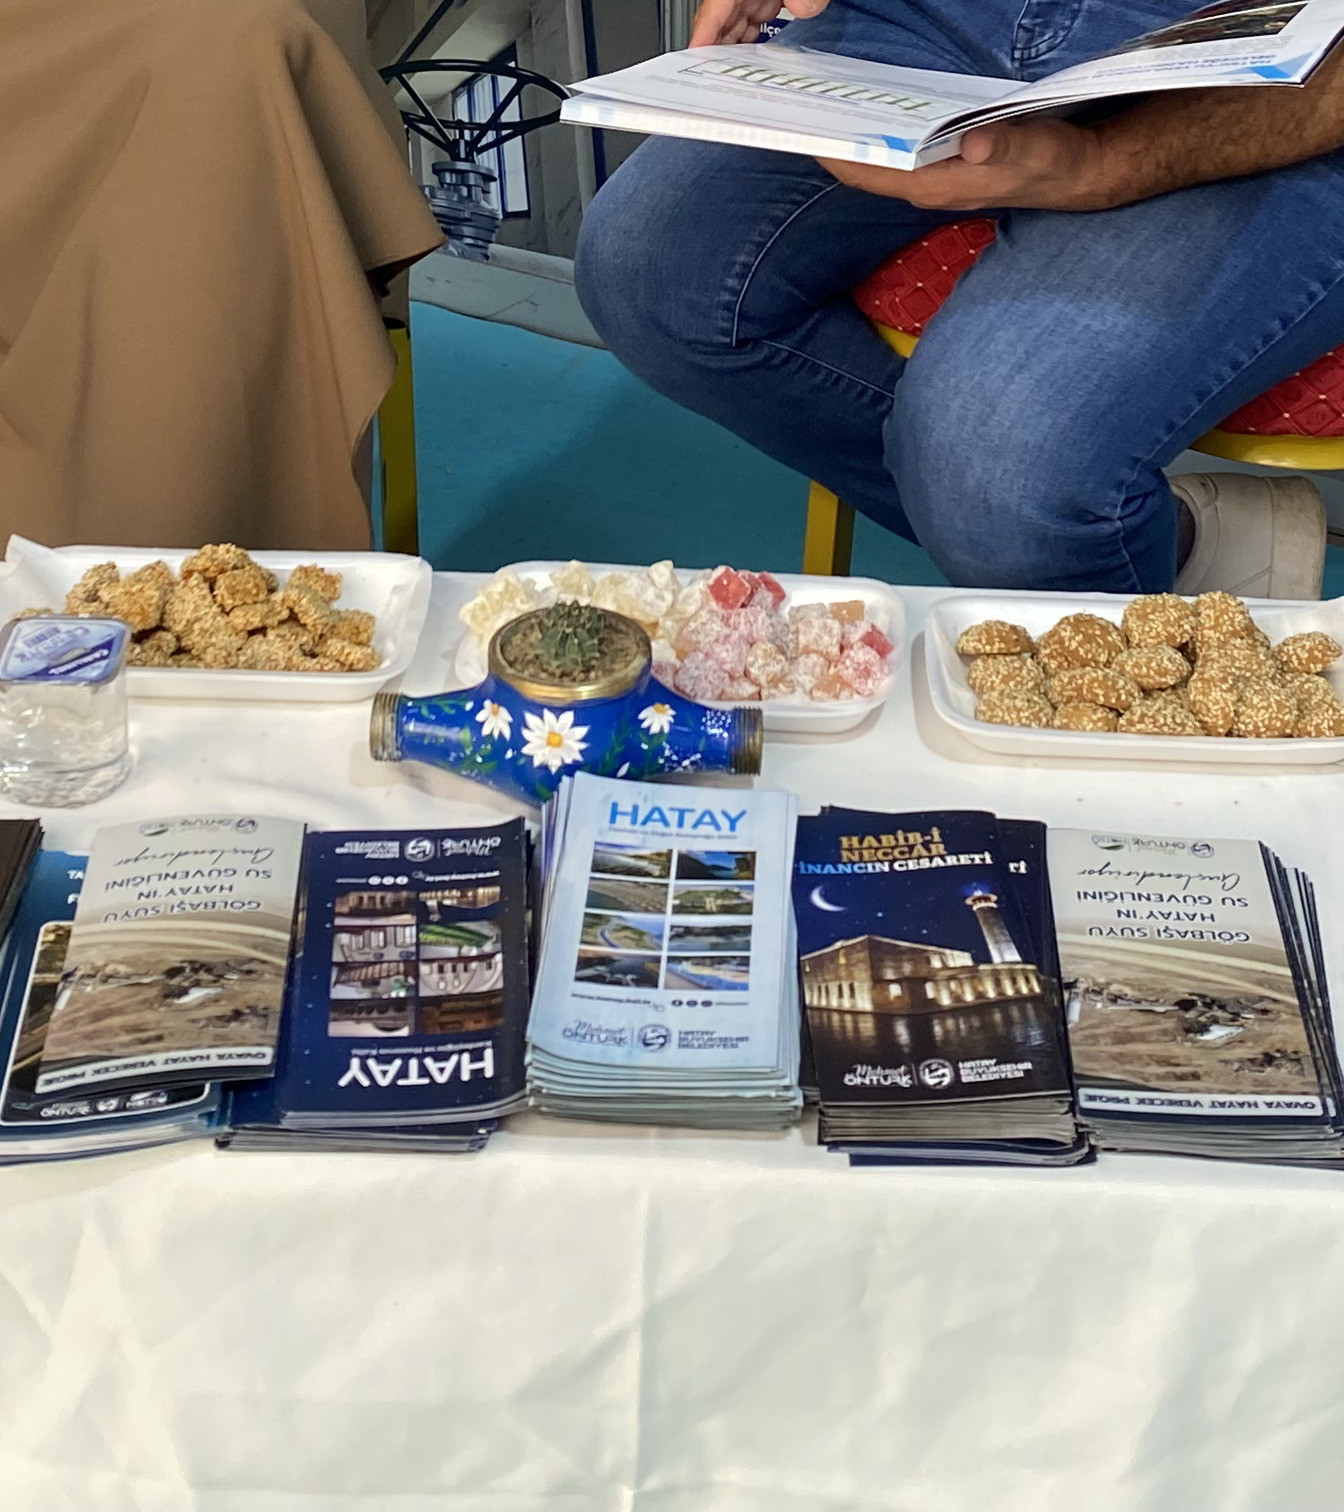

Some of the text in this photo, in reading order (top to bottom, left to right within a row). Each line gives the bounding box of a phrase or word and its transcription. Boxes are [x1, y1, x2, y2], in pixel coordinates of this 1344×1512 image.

[609, 801, 747, 832] HATAY
[799, 851, 994, 874] İNANCIN CESARETİ
[245, 869, 272, 879] SU
[1077, 890, 1248, 907] SU GÜVENLİĞİNİ
[103, 905, 160, 923] SUYU
[1117, 909, 1215, 922] HATAY'IN
[1088, 926, 1250, 942] GÖLBAŞI SUYU
[338, 1049, 494, 1087] HATAY
[1209, 1100, 1258, 1109] HAYAT
